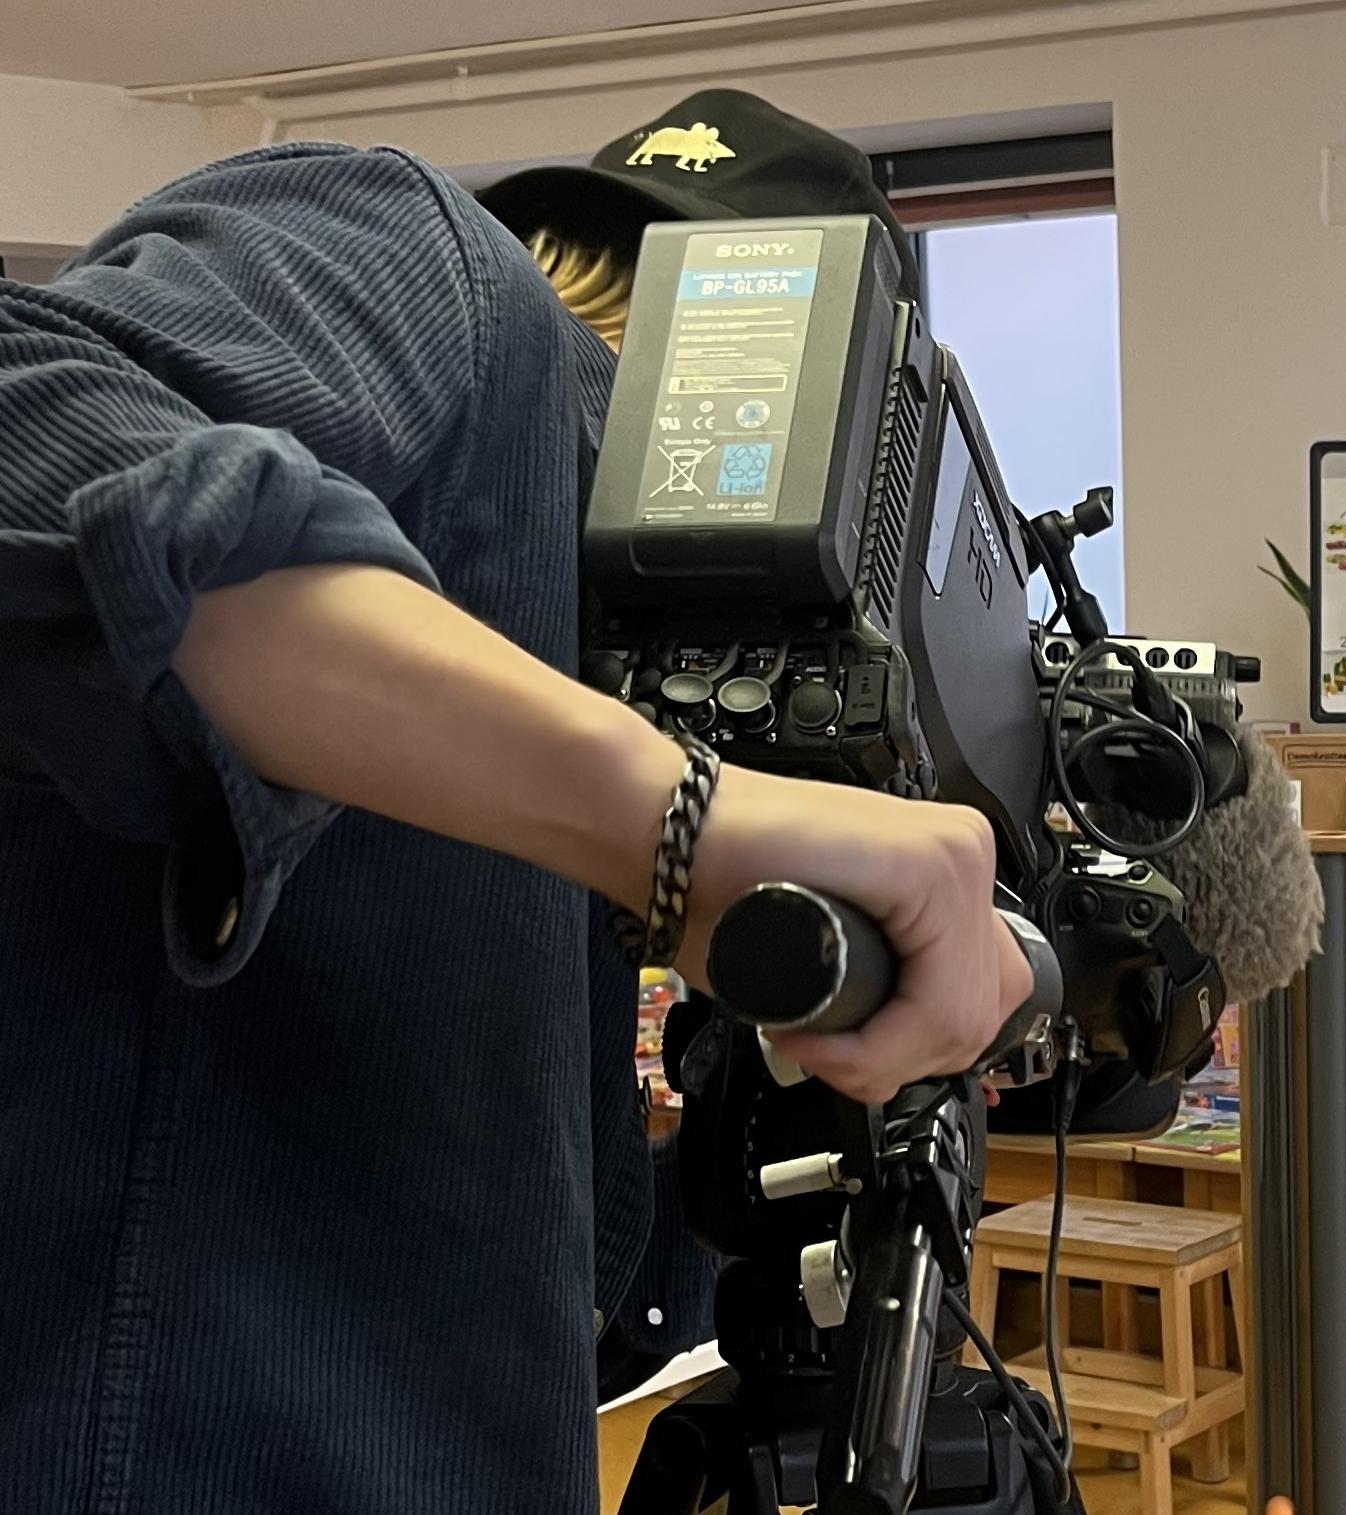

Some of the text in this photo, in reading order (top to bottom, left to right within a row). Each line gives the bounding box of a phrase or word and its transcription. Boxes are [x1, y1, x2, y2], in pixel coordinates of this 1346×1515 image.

[716, 243, 789, 257] SONY
[701, 278, 789, 296] BP-GL95A
[966, 525, 993, 610] HD
